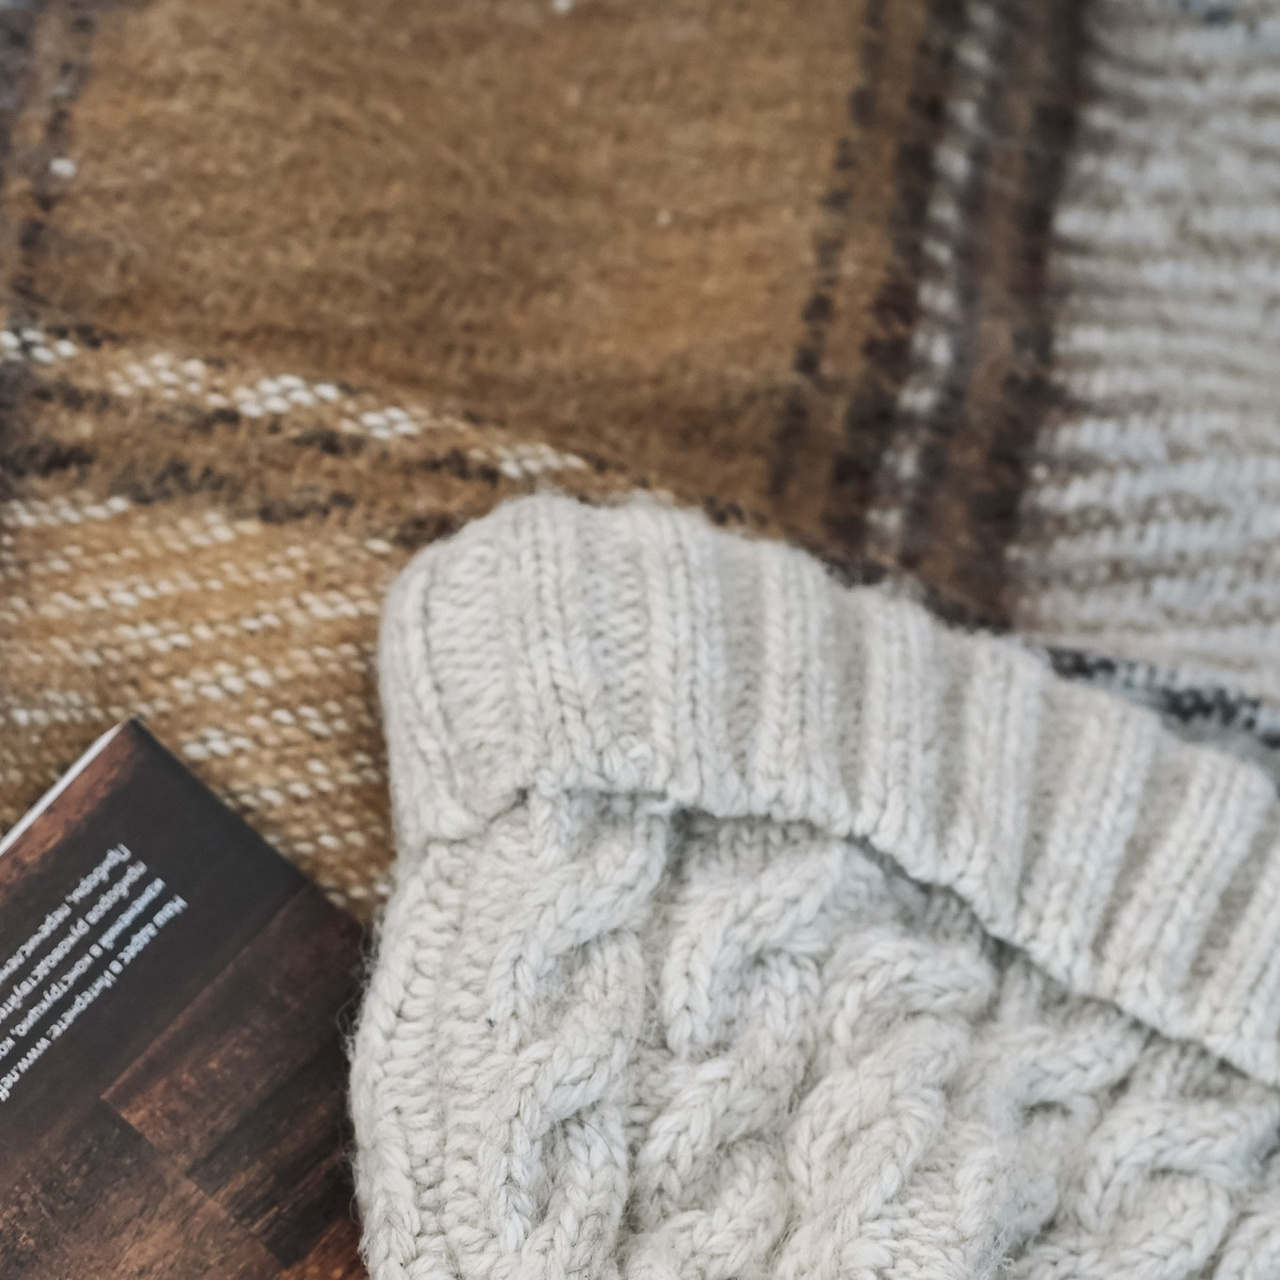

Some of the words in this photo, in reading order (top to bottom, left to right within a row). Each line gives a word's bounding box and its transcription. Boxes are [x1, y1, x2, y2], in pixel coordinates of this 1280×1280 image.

[88, 943, 103, 957] в
[108, 959, 123, 974] в
[8, 952, 94, 1037] конструкцию,
